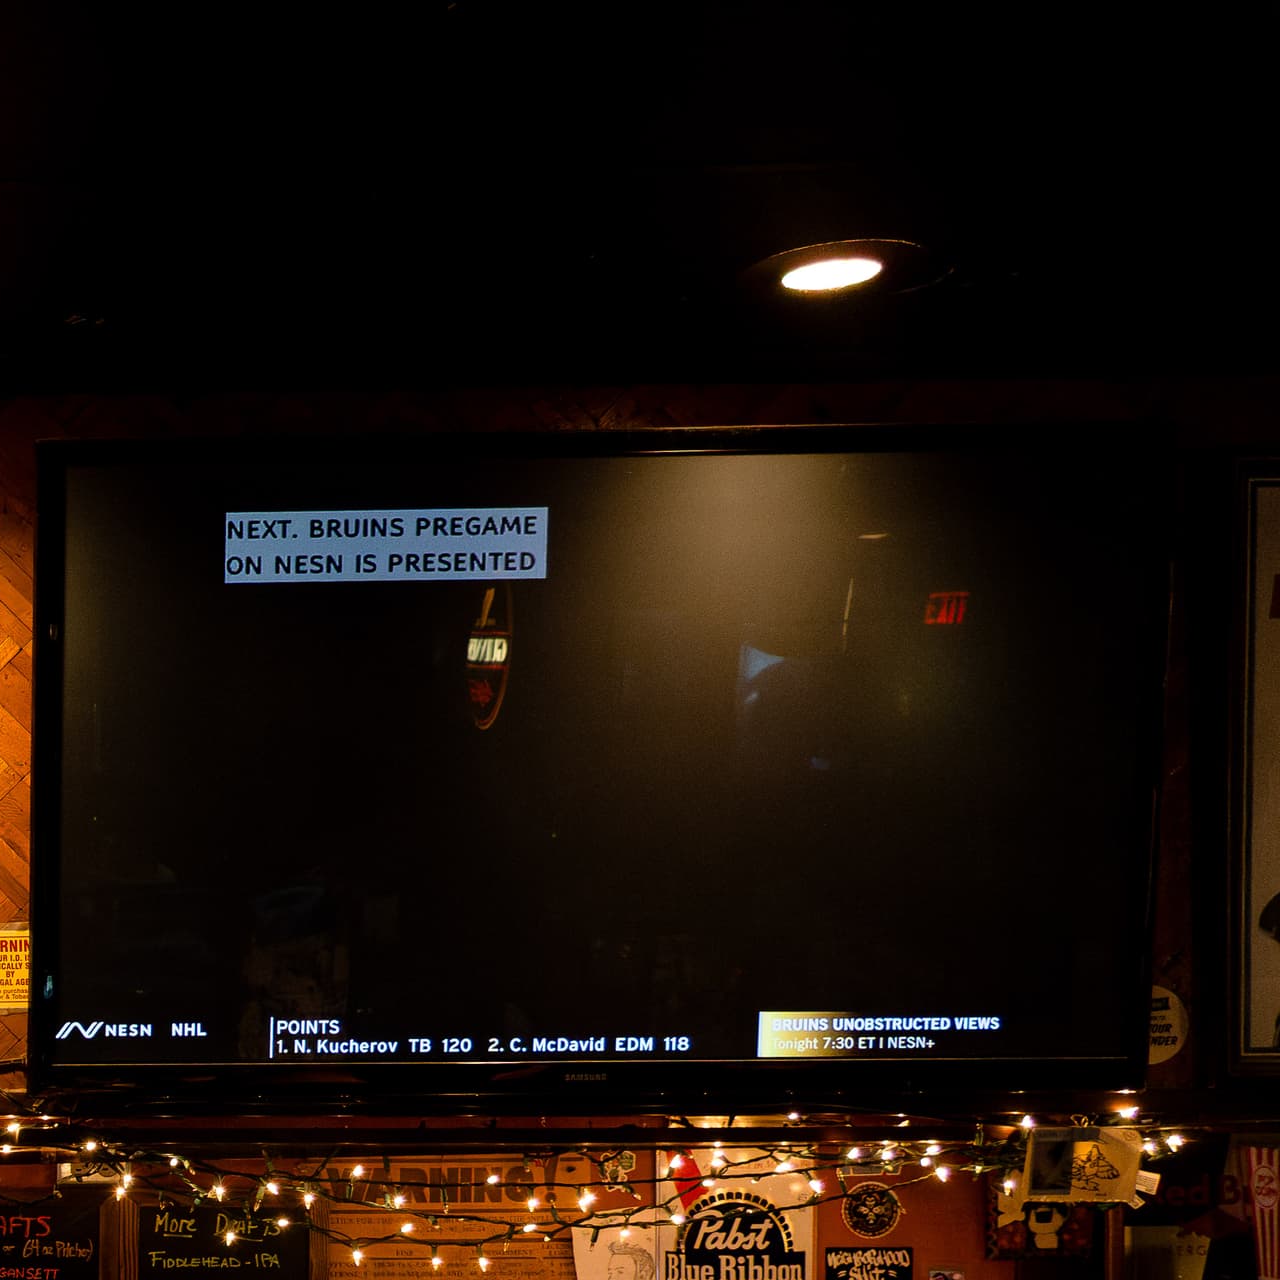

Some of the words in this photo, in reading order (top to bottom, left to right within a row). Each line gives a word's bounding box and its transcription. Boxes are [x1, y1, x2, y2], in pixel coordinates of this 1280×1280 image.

[227, 519, 298, 539] NEXT.
[310, 518, 404, 539] BRUINS
[416, 516, 538, 537] PREGAME
[226, 556, 262, 575] ON
[275, 555, 342, 574] NESN
[356, 554, 377, 573] IS
[389, 552, 536, 572] PRESENTED
[105, 1024, 152, 1038] NESN
[171, 1023, 207, 1037] NHL
[276, 1020, 340, 1035] POINTS
[772, 1018, 829, 1032] BRUINS
[833, 1017, 951, 1031] UNOBSTRUCTED
[954, 1017, 1000, 1030] VIEWS
[277, 1039, 289, 1053] 1.
[293, 1039, 311, 1053] N.
[316, 1038, 398, 1054] Kucherov
[408, 1039, 431, 1053] TB
[441, 1038, 472, 1053] 120
[488, 1038, 504, 1053] 2.
[510, 1038, 527, 1052] C.
[532, 1037, 605, 1052] McDavid
[615, 1038, 654, 1052] EDM
[663, 1037, 690, 1051] 118
[822, 1037, 854, 1050] 7:30
[858, 1037, 876, 1049] ET
[888, 1036, 936, 1049] NESN+
[690, 1209, 773, 1250] Pabst
[255, 1252, 280, 1268] IPA
